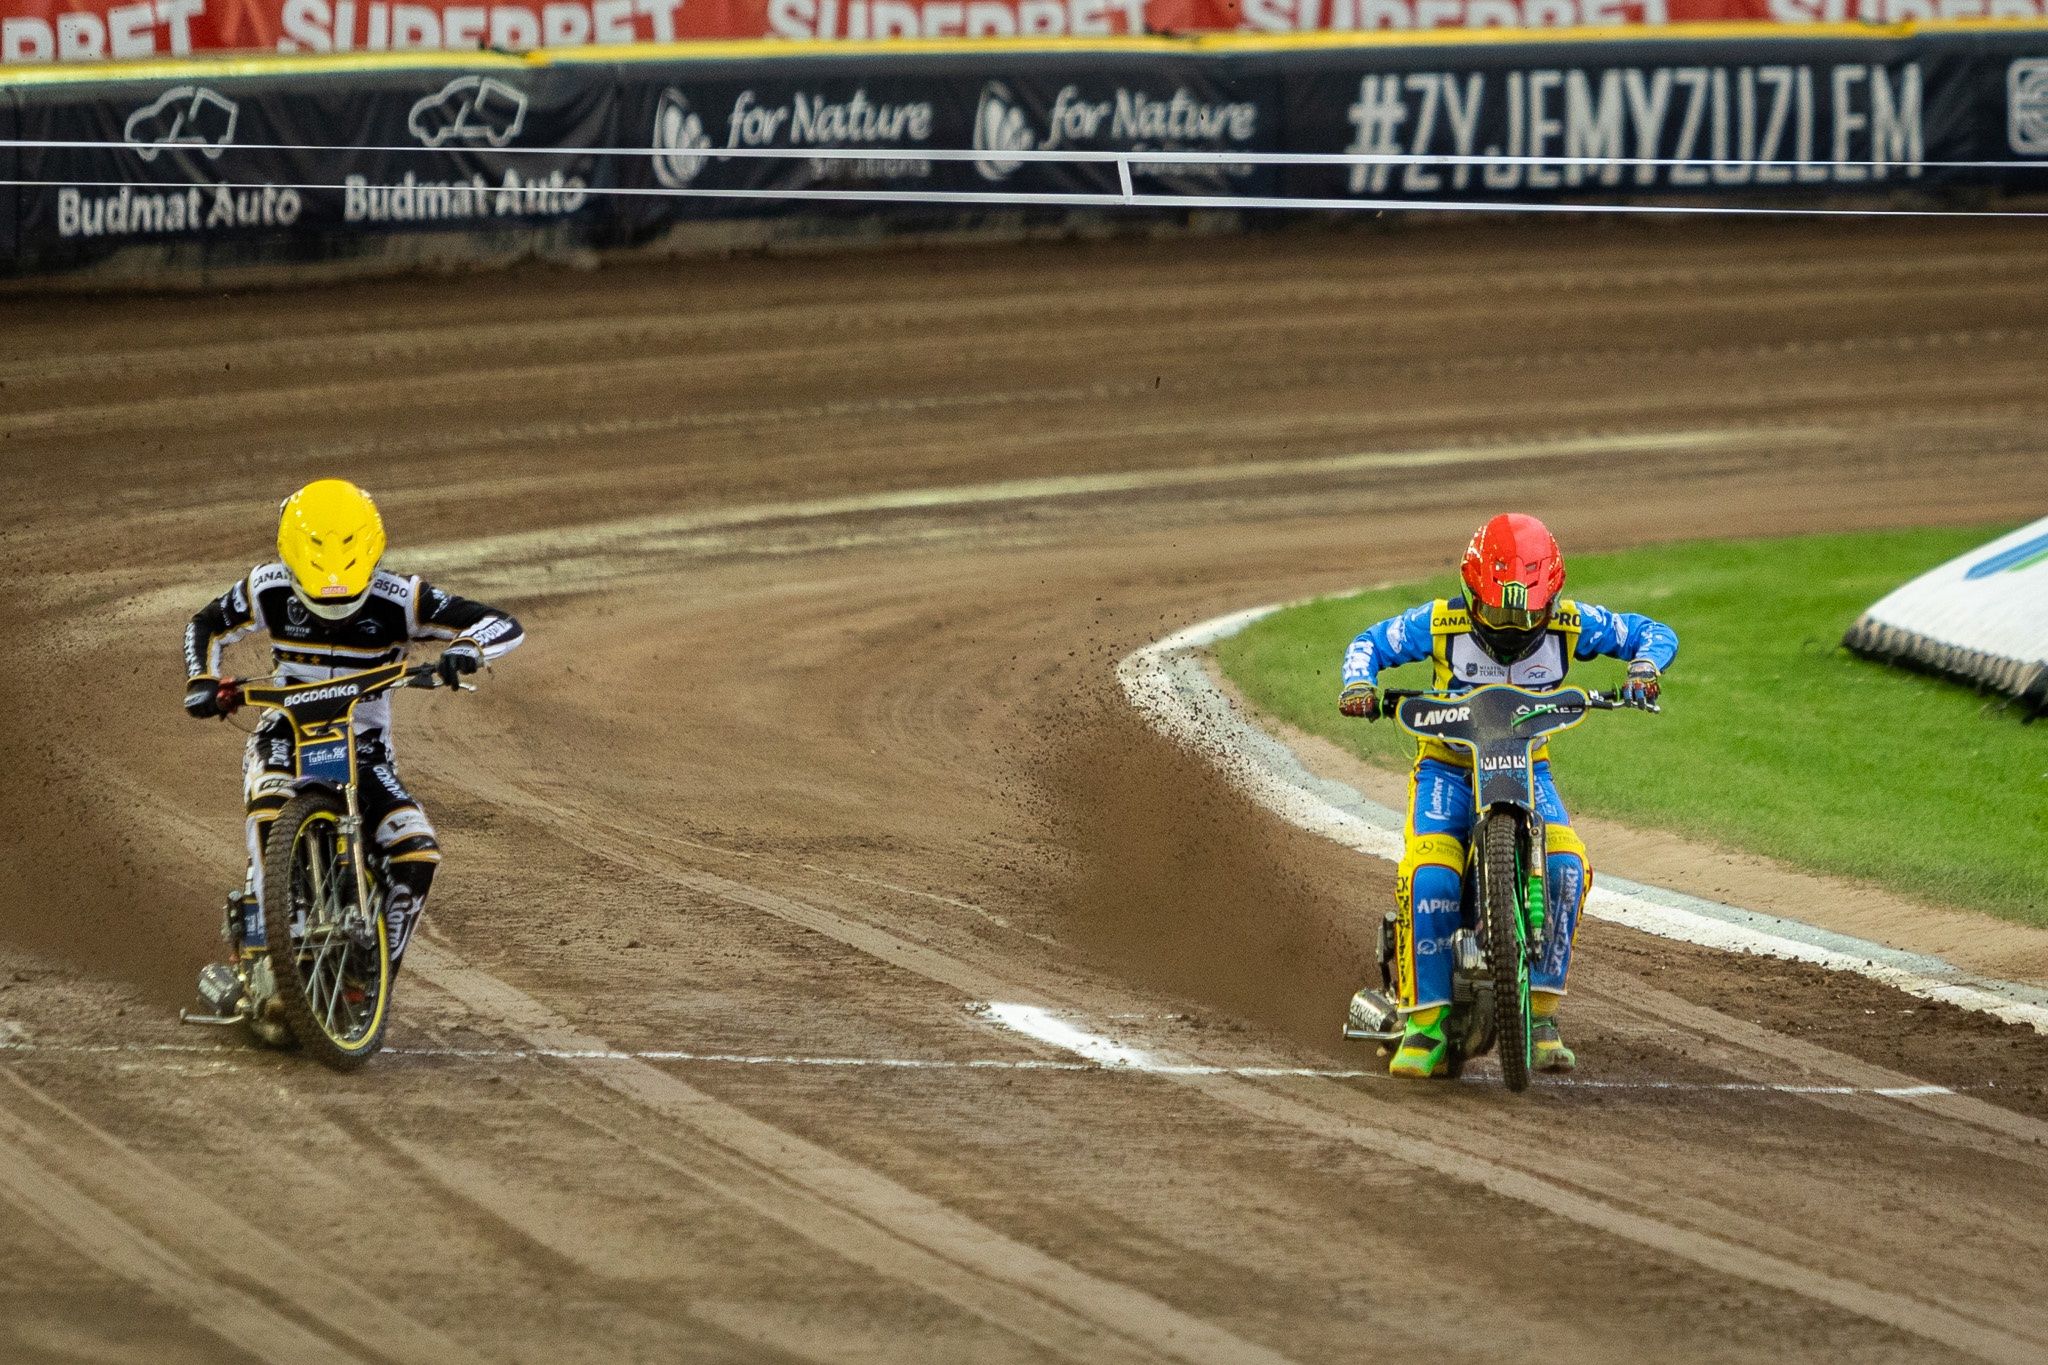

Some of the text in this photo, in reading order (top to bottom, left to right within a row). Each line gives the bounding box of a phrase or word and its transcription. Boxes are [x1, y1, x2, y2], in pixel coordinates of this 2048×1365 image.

[719, 89, 932, 161] for Nature
[1038, 85, 1256, 151] for Nature
[58, 182, 301, 236] Budmat Auto
[344, 168, 587, 222] Budmat Auto
[284, 684, 359, 707] BOGDANKA
[1414, 706, 1471, 727] LAVOR
